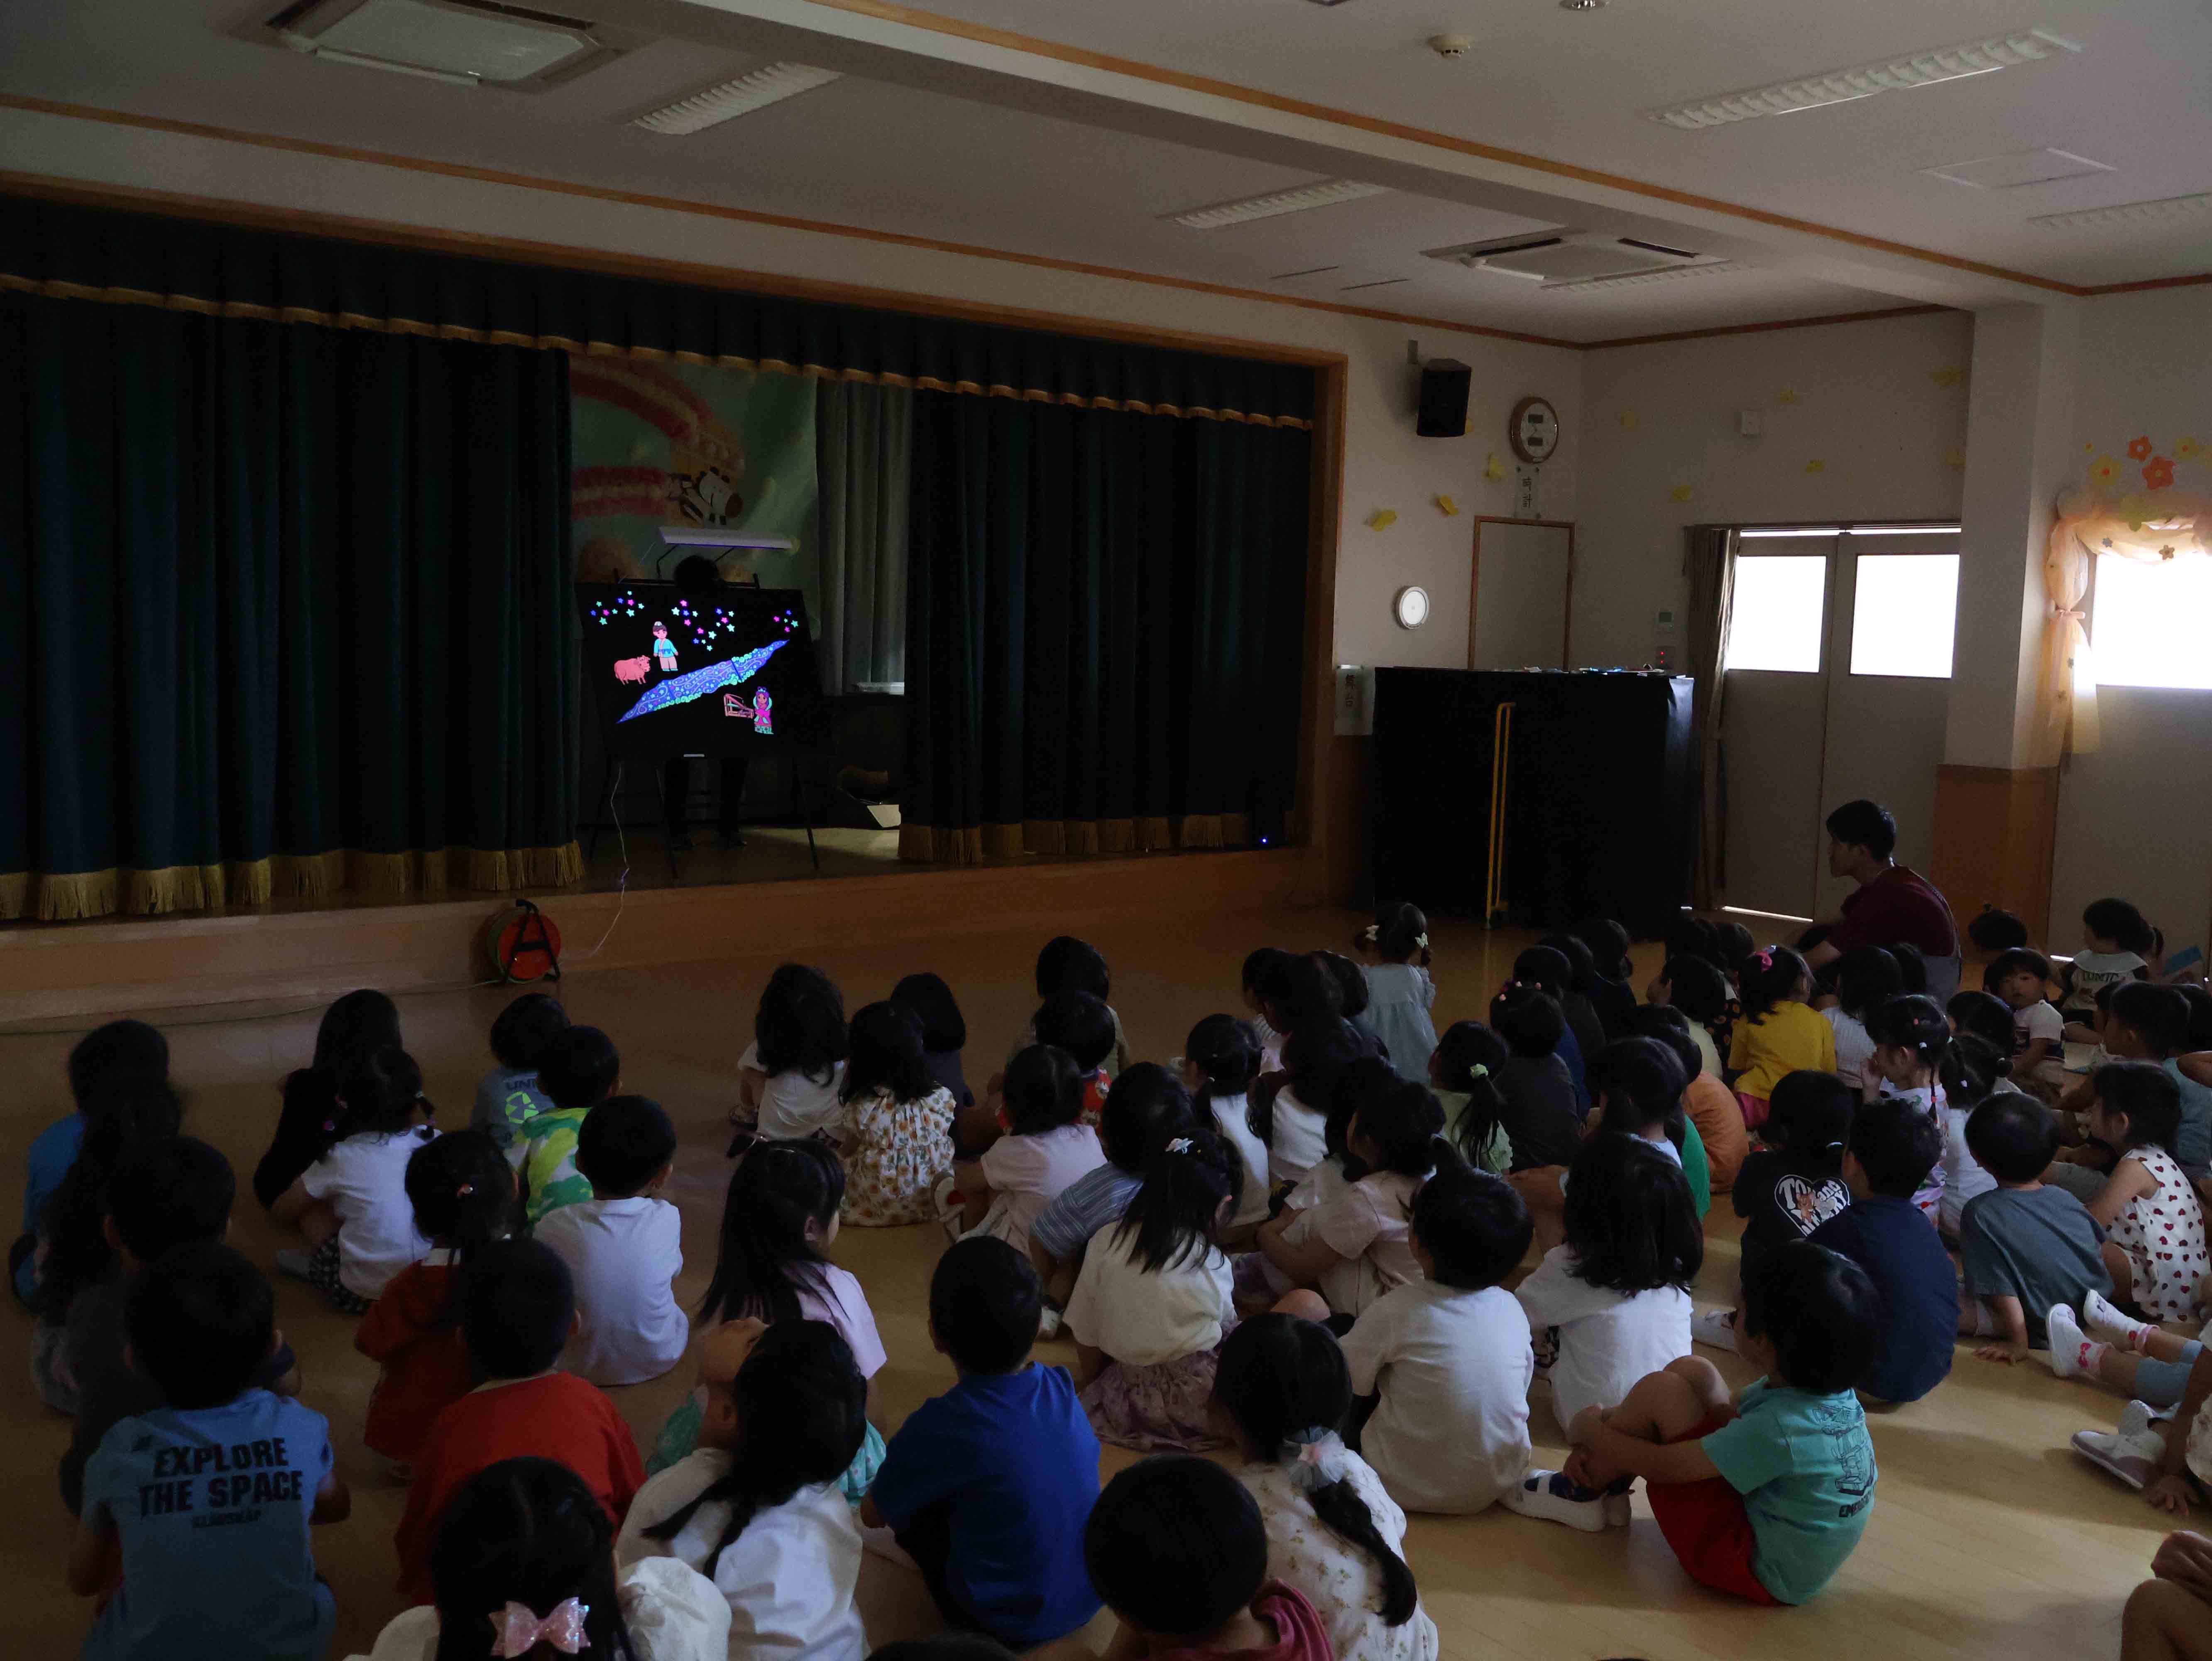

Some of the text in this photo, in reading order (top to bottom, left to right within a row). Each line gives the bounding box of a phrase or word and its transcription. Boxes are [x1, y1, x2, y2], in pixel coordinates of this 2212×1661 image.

[154, 1438, 289, 1478] EXPLORE
[139, 1480, 193, 1521] THE
[209, 1470, 303, 1508] SPACE
